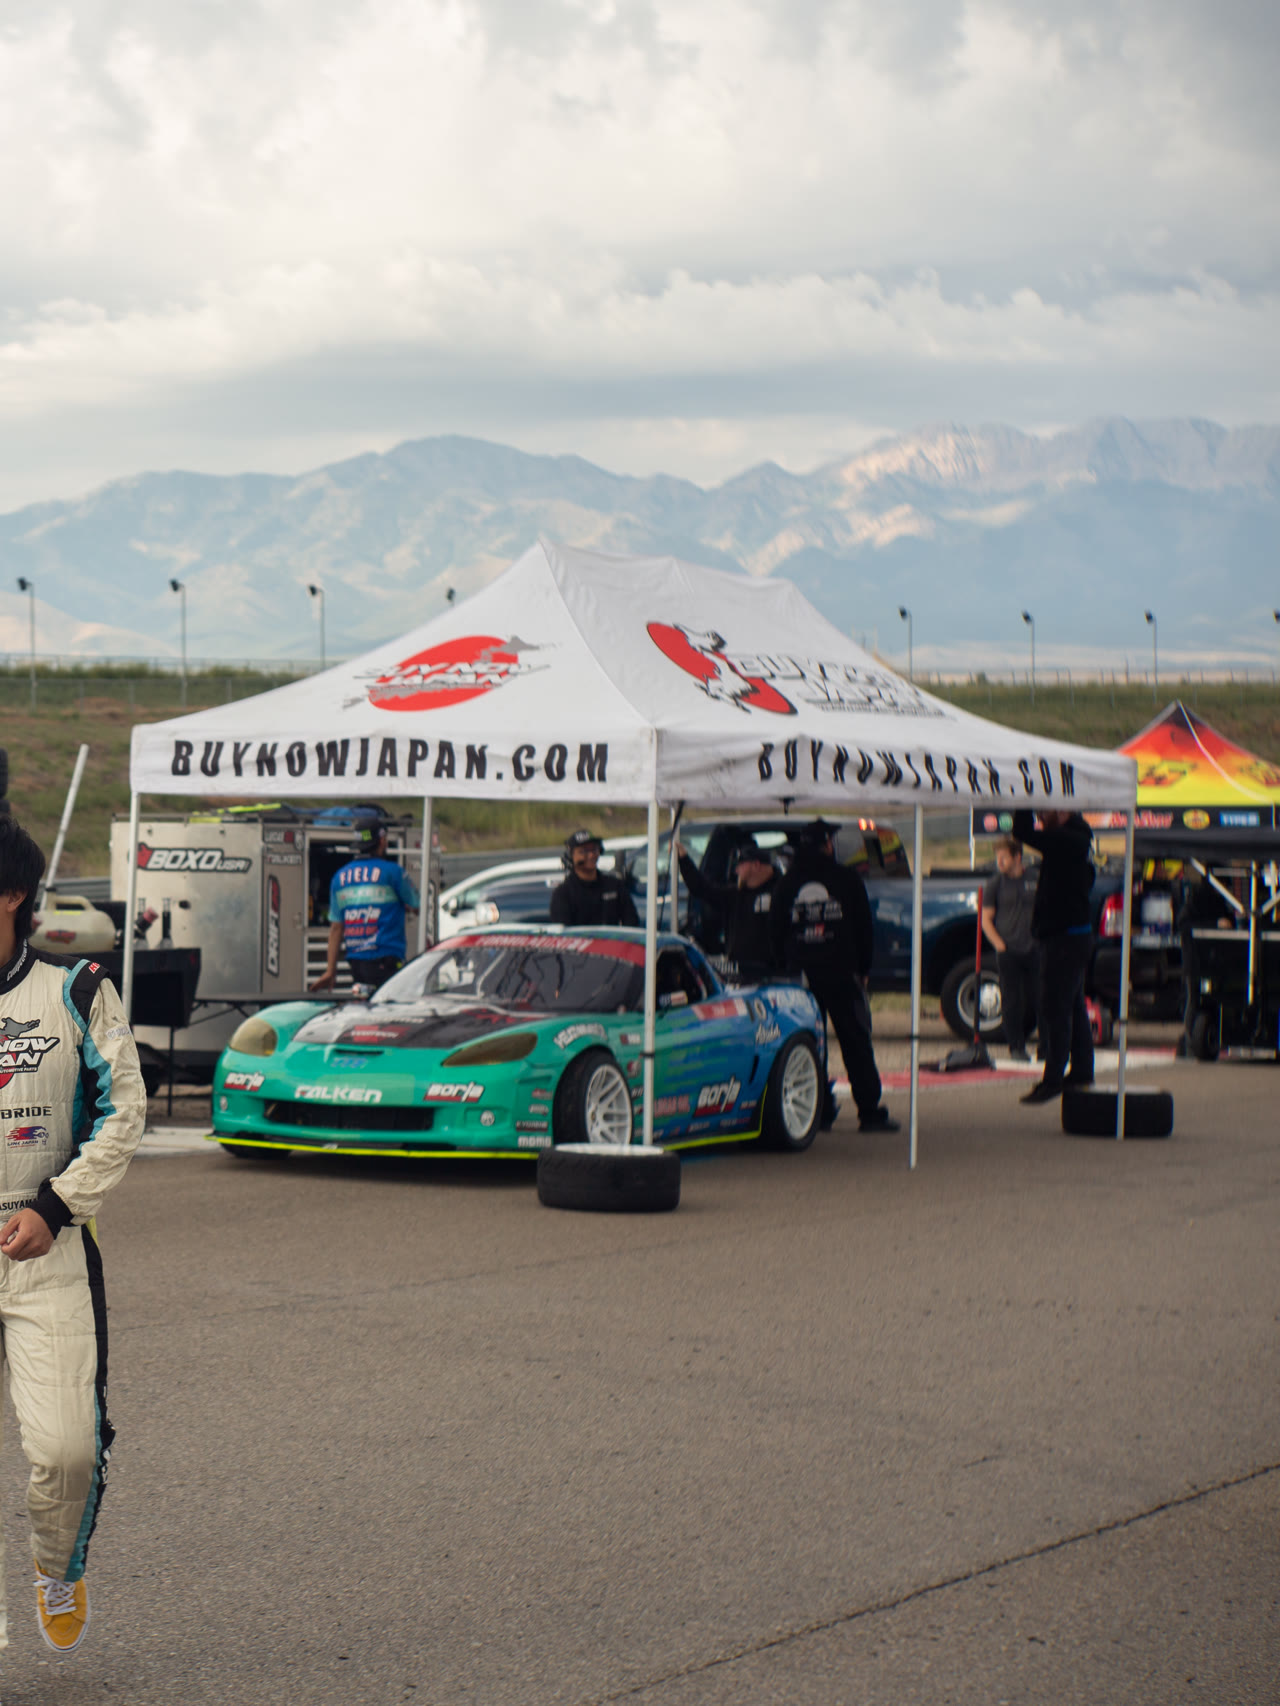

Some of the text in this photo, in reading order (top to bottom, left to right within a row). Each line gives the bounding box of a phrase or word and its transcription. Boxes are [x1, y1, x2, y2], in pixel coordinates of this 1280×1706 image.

[171, 738, 609, 783] BUYNOWJAPAN.COM
[147, 850, 221, 870] BOXO
[340, 867, 380, 886] FIELD
[294, 1084, 382, 1103] FALKEN
[0, 1106, 52, 1119] BRIDE
